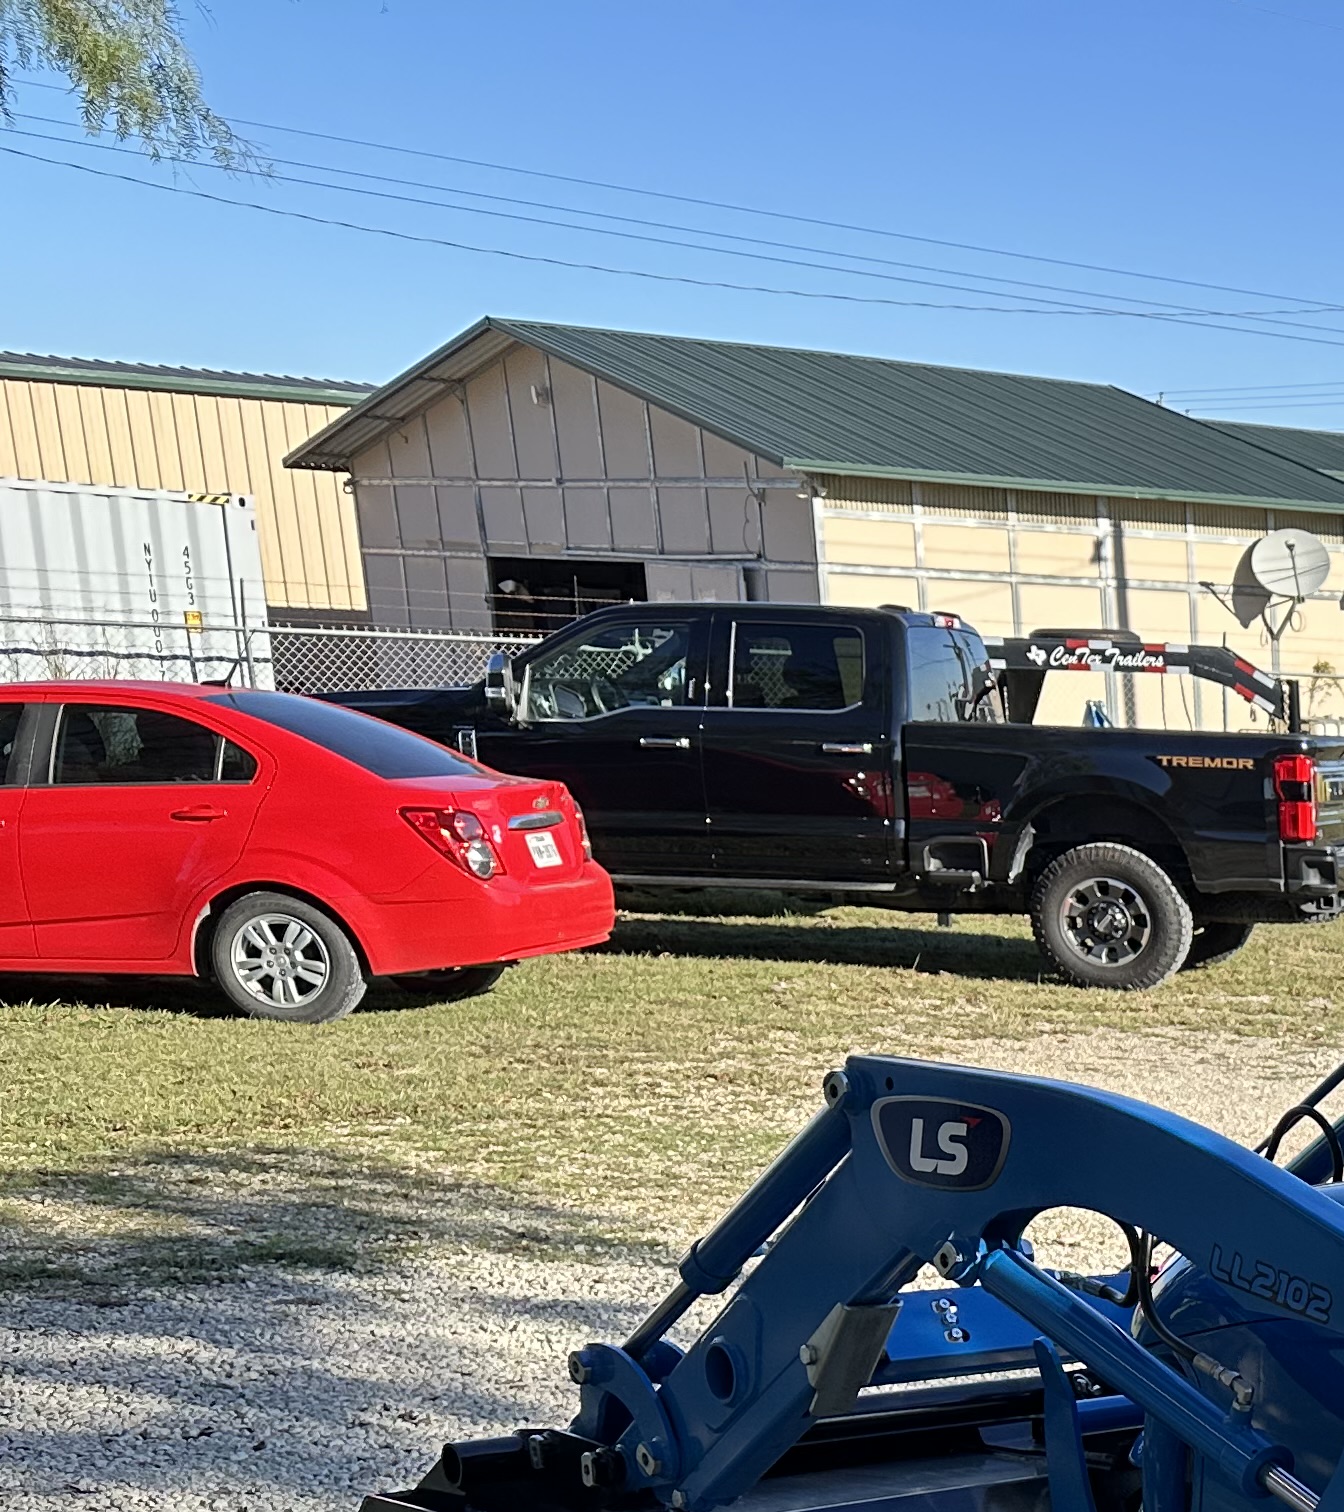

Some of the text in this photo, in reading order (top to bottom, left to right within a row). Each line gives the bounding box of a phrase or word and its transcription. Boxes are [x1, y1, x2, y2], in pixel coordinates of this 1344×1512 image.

[1050, 645, 1164, 667] CenTex Trailers
[1157, 755, 1254, 770] TREMOR
[909, 1118, 968, 1176] LS
[1208, 1241, 1333, 1325] LL2102
